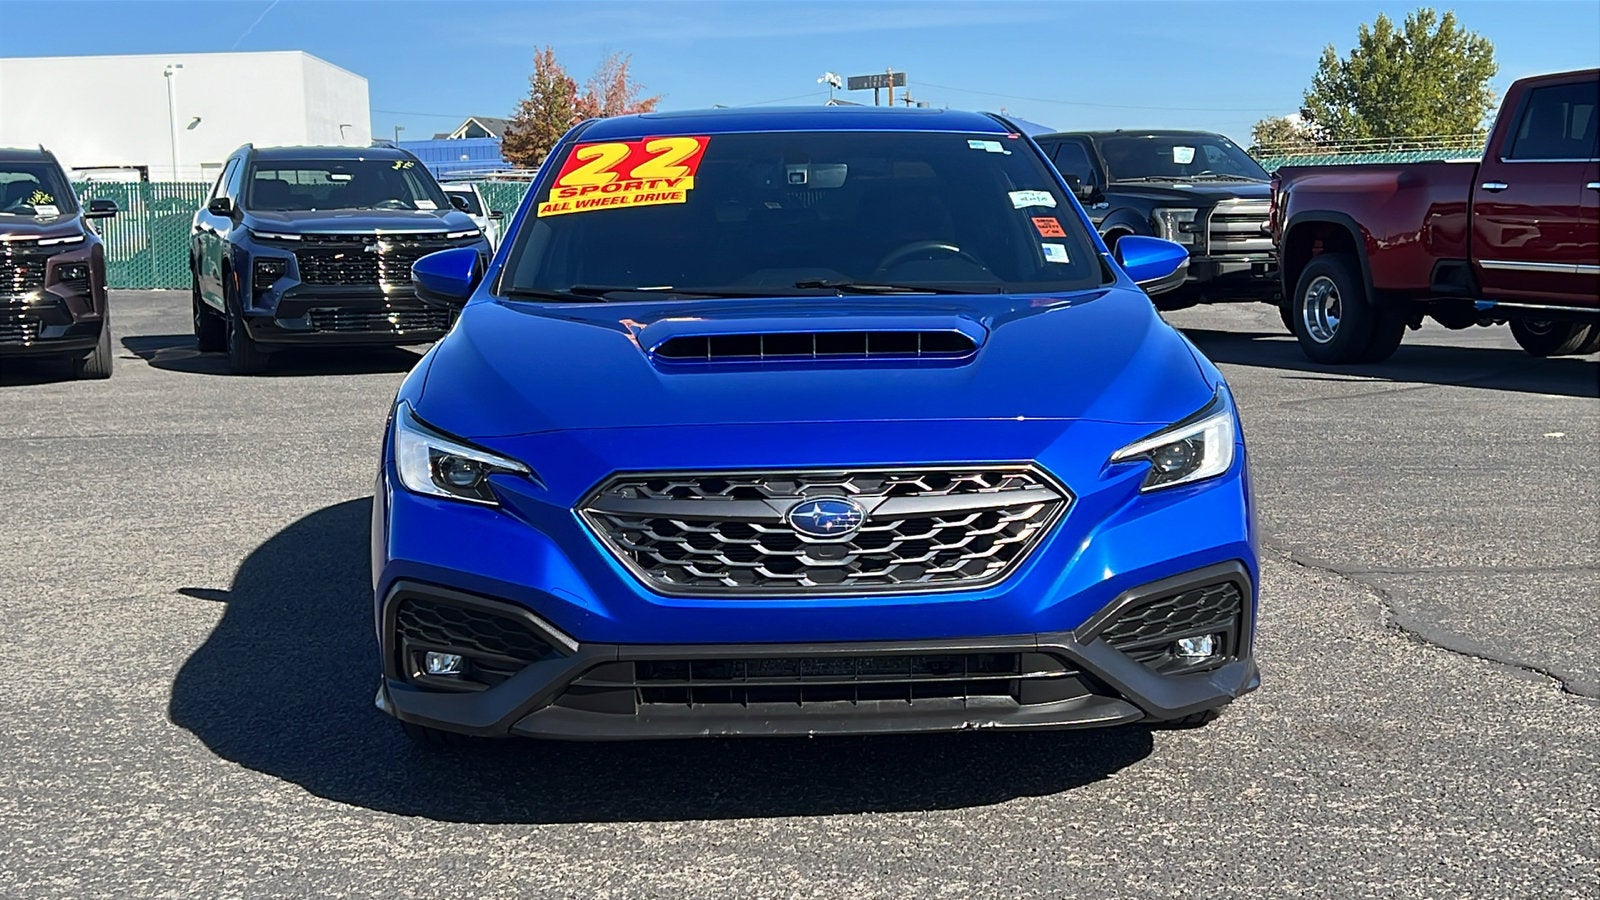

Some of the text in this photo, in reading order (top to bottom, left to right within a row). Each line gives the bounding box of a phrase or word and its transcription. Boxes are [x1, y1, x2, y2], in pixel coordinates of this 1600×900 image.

[559, 137, 700, 187] 22
[558, 178, 683, 198] SPORTY
[541, 191, 683, 214] ALL WHEEL DRIVE
